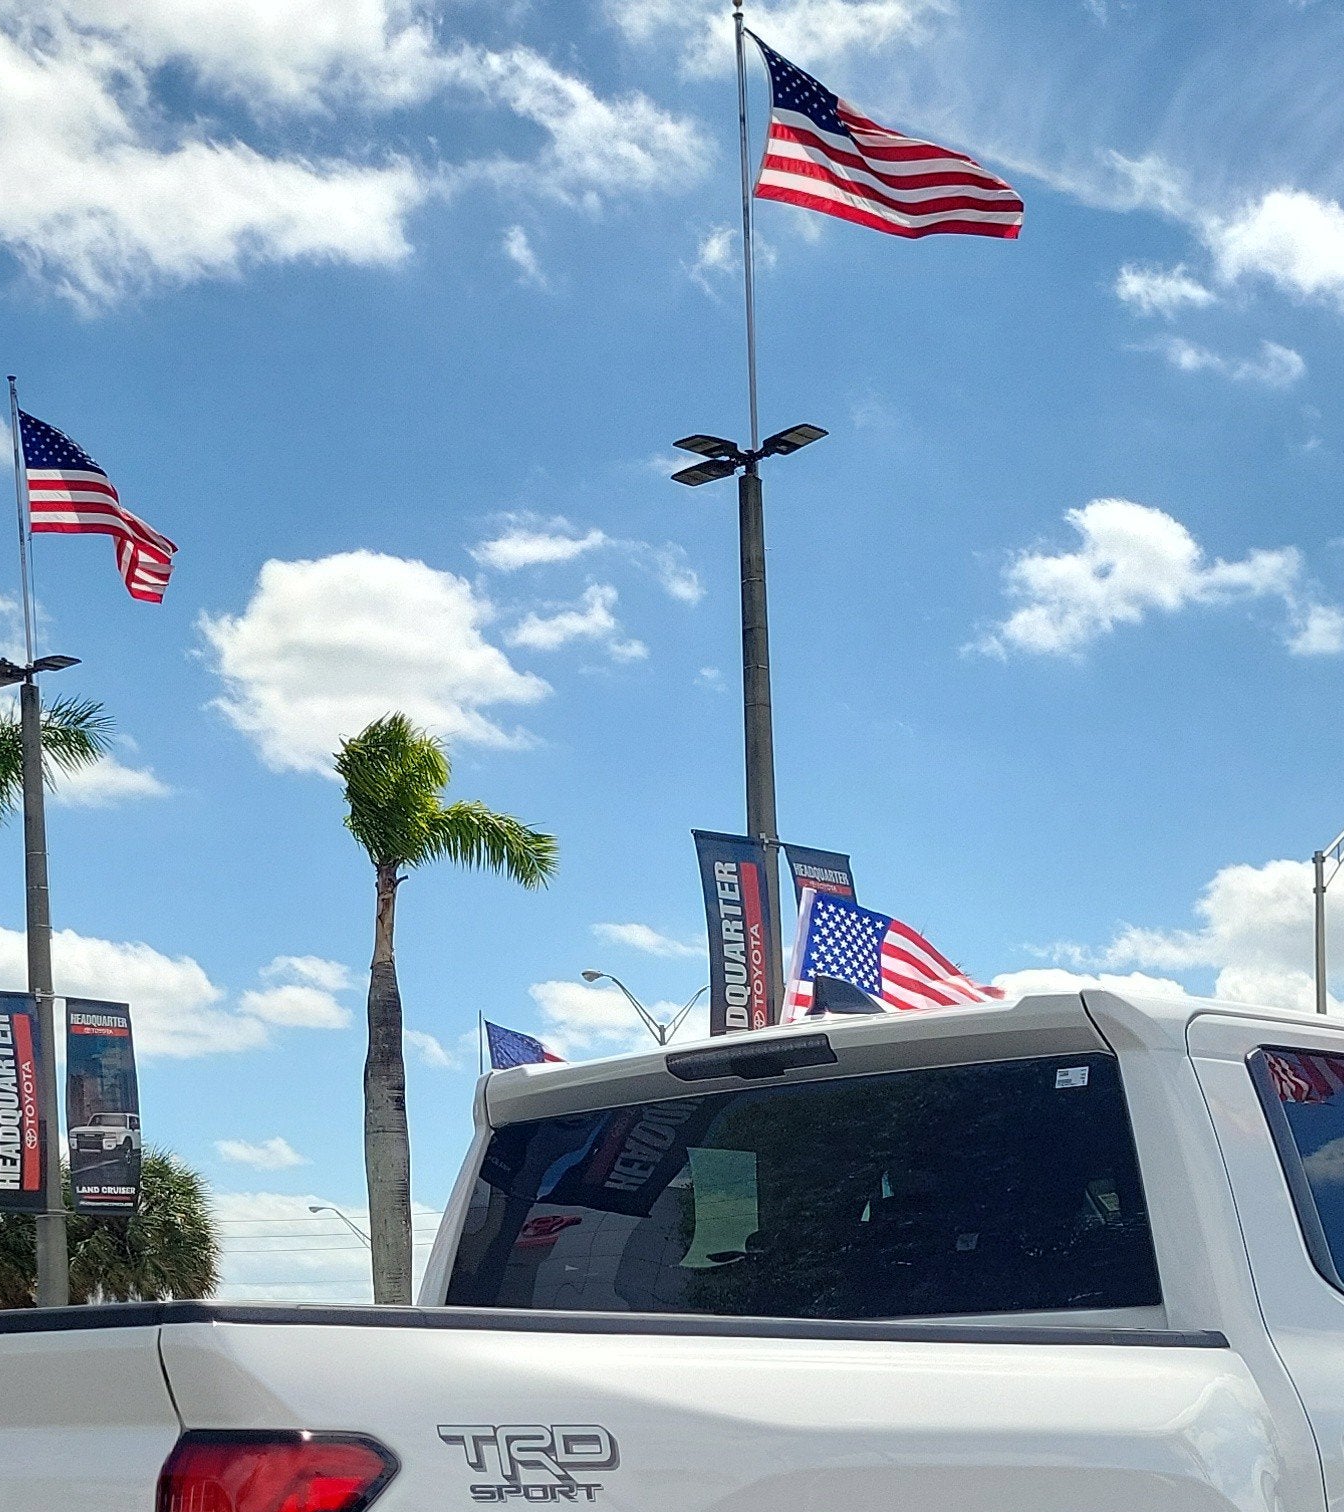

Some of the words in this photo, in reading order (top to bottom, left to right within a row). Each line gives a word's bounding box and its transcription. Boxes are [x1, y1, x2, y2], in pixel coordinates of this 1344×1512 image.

[793, 862, 850, 886] HEADQUARTER
[714, 861, 749, 1034] DQUARTER
[750, 923, 765, 1008] TOYOTA
[70, 1013, 128, 1028] HEADQUARTER
[21, 1060, 37, 1126] TOYOTA
[76, 1186, 100, 1194] LAND
[101, 1186, 136, 1195] CRUISER
[437, 1424, 621, 1485] TRD
[469, 1483, 604, 1503] SPORT
